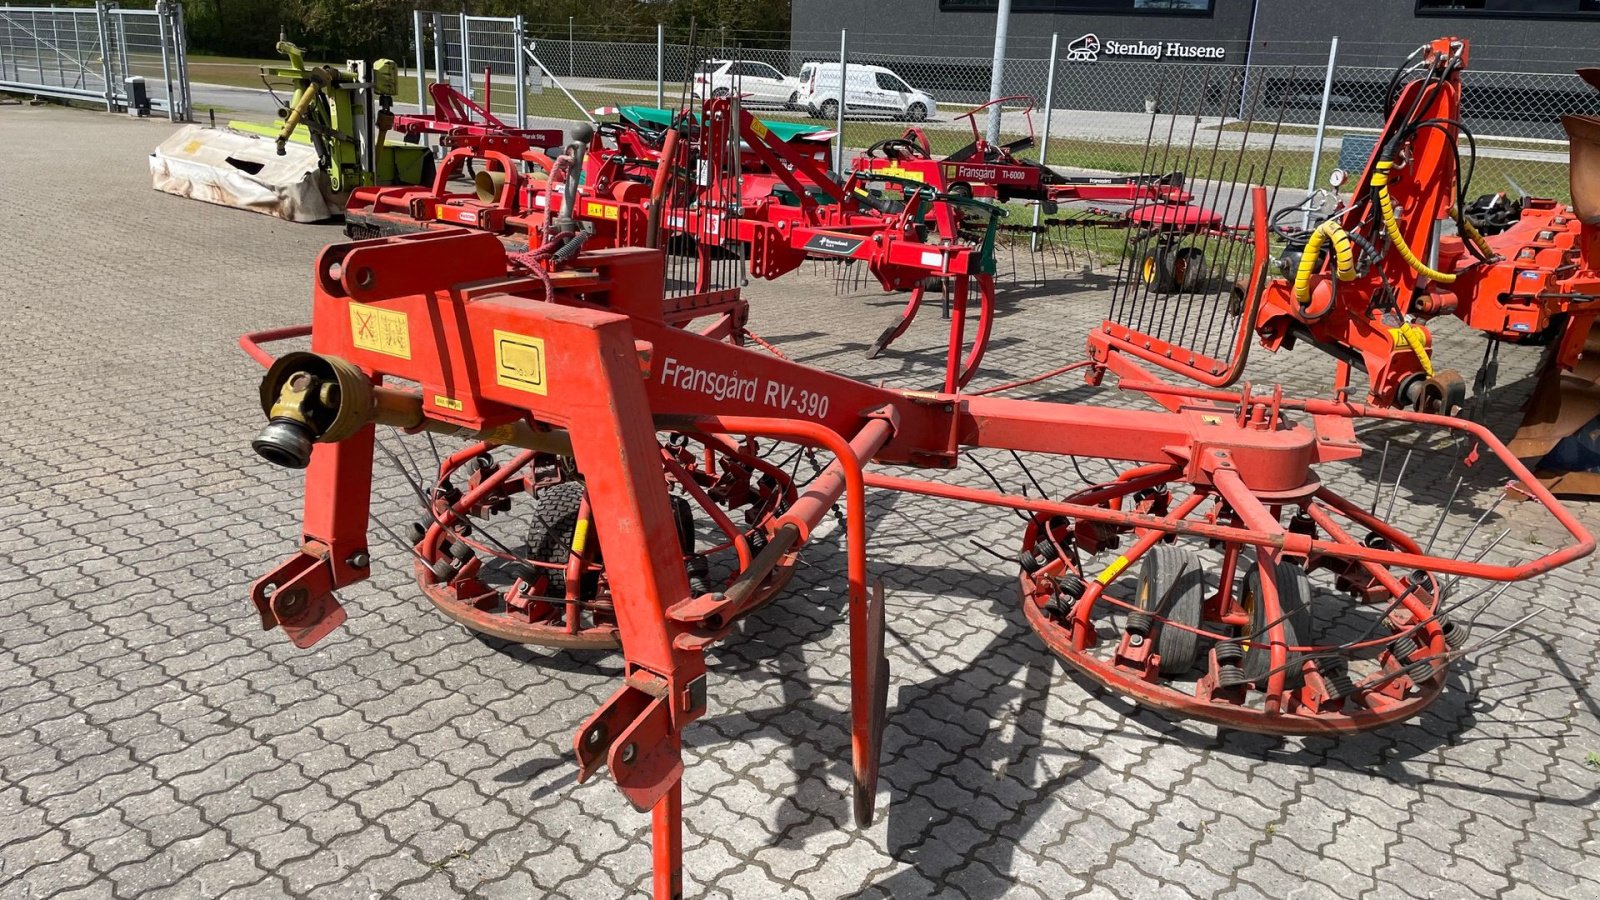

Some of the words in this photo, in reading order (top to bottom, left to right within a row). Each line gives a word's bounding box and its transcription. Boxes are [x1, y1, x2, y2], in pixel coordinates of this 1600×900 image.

[1105, 41, 1163, 60] Stenhøj
[1166, 42, 1225, 58] Husene
[958, 165, 996, 180] Fransgård
[1002, 170, 1026, 180] TI-6000
[661, 357, 759, 403] Fransgård
[763, 380, 830, 419] RV-390
